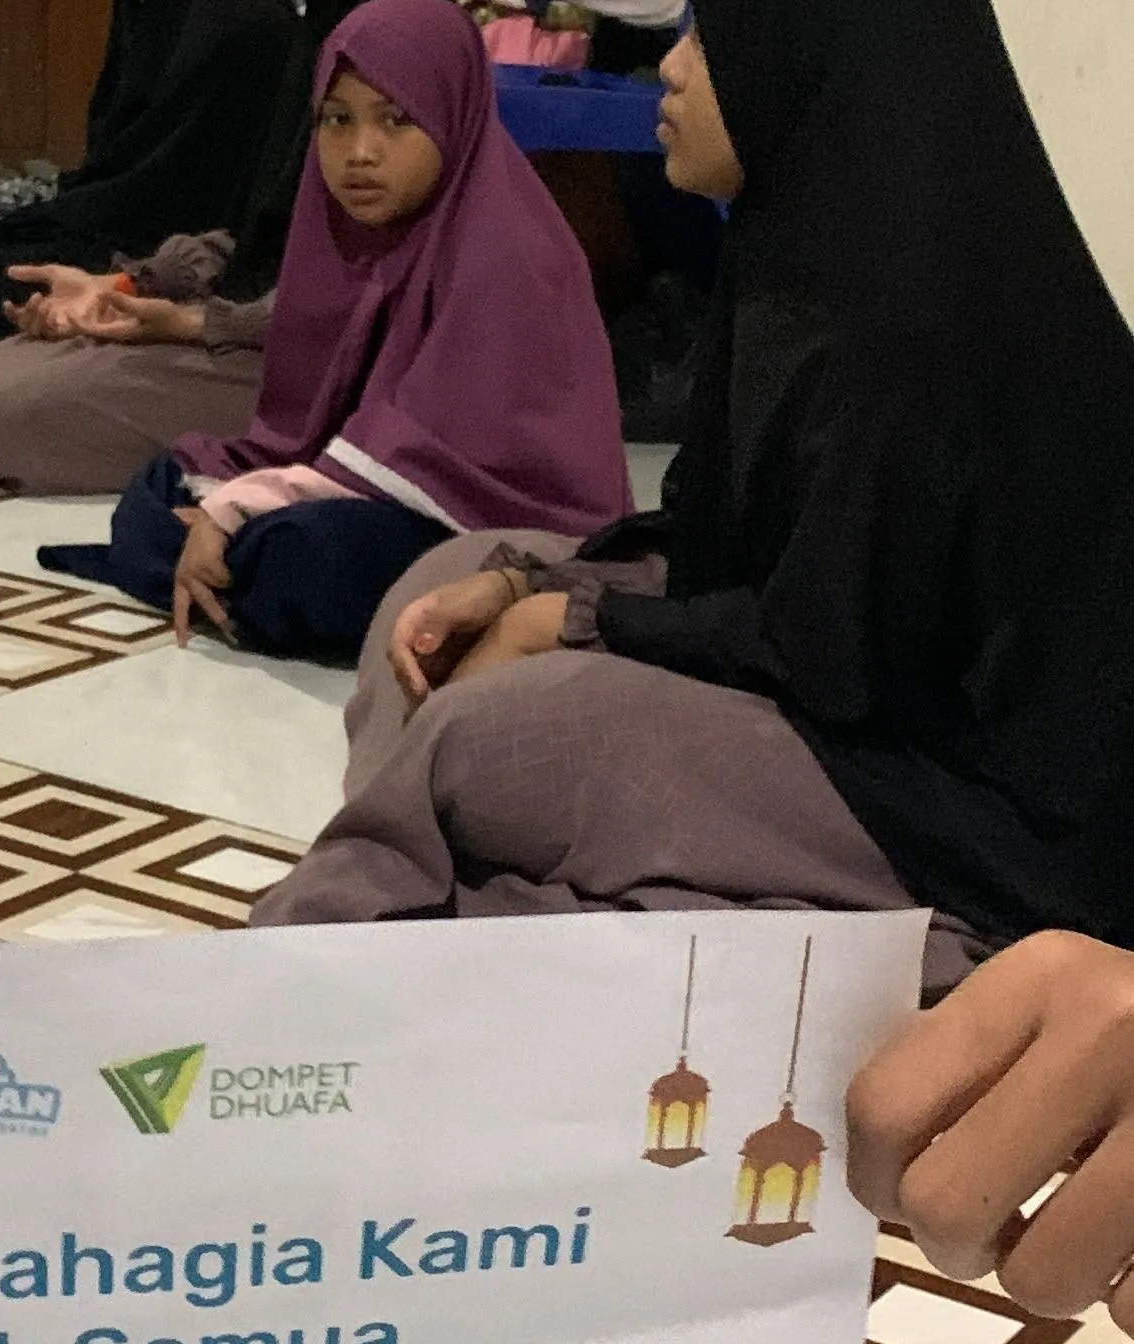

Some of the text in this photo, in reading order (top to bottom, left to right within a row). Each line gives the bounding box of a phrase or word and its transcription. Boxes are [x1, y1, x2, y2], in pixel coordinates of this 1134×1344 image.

[210, 1062, 361, 1091] DOMPET
[210, 1091, 352, 1120] DHUAFA
[359, 1207, 592, 1281] Kami
